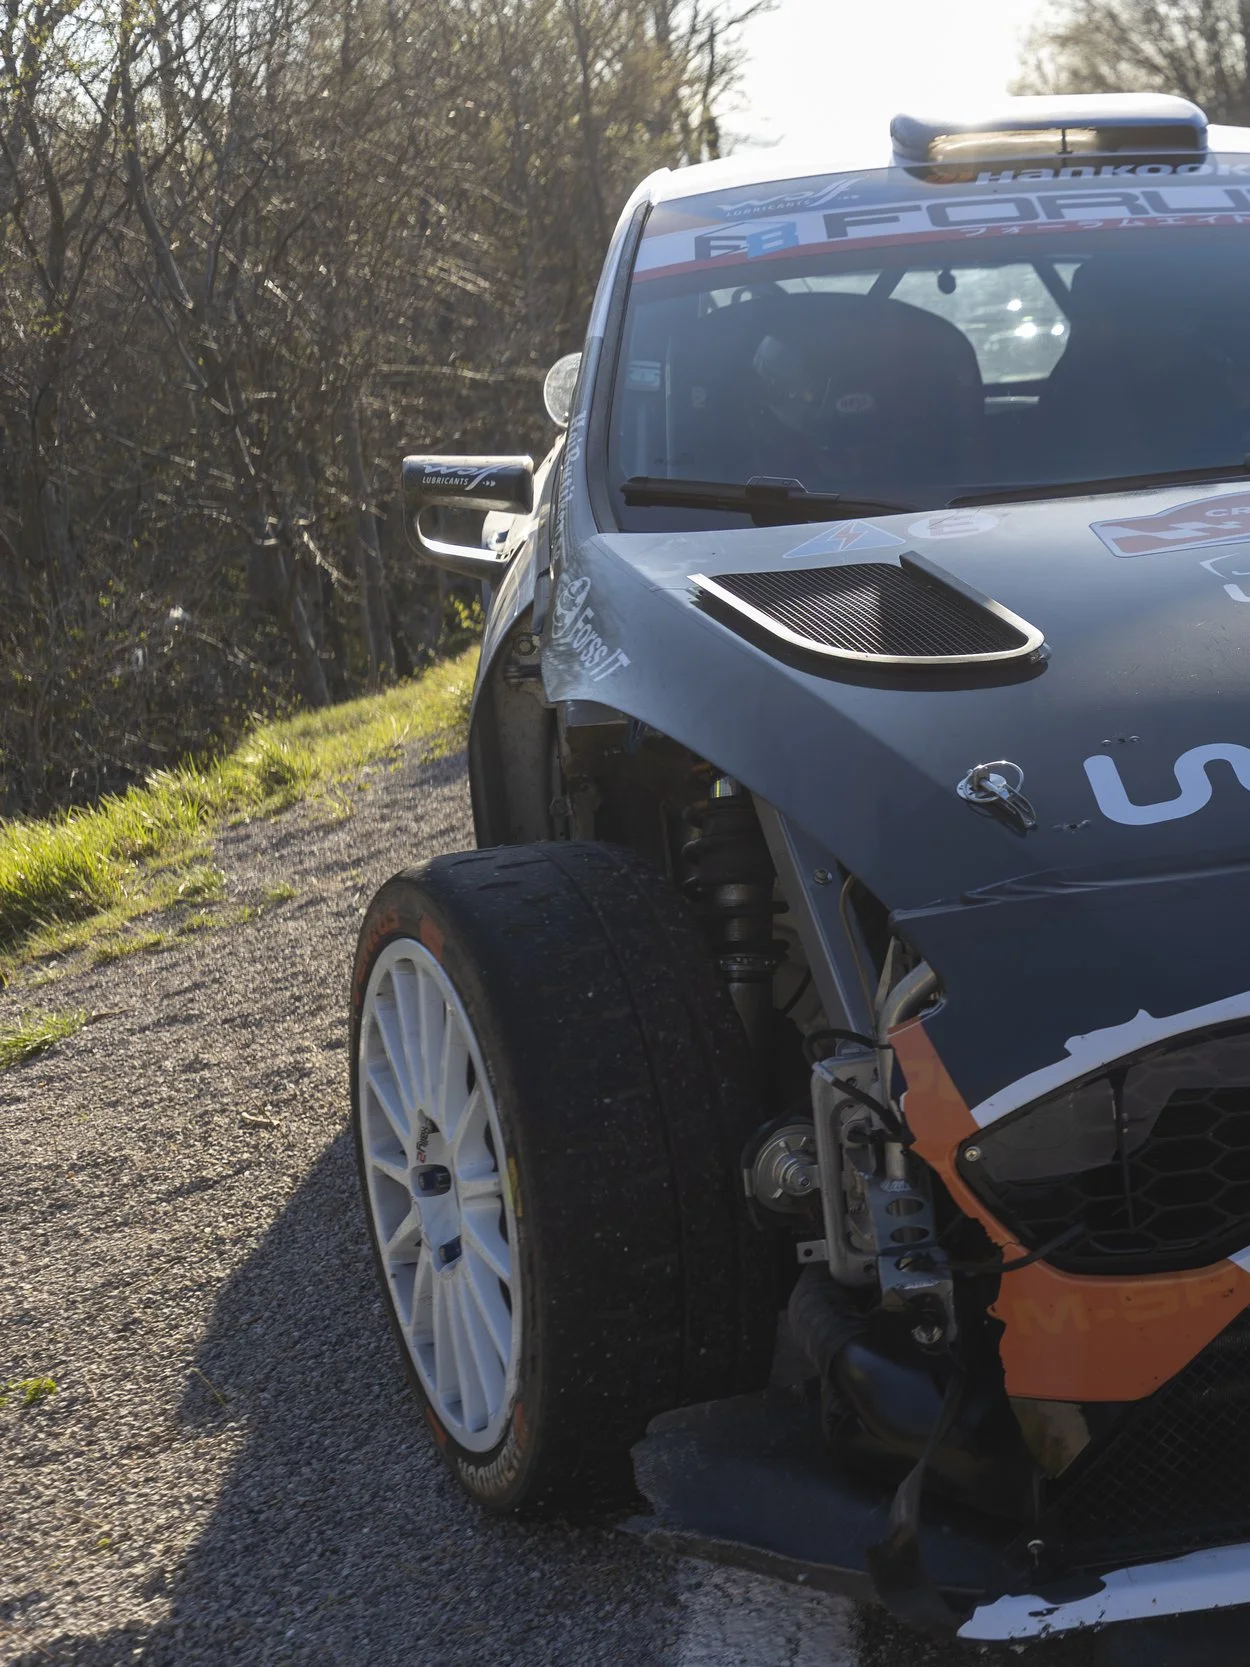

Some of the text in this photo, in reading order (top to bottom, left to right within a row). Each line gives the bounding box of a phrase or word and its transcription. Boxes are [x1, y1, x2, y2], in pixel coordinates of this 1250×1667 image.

[422, 476, 469, 486] LUBRICANTS
[567, 606, 632, 682] Forss IT
